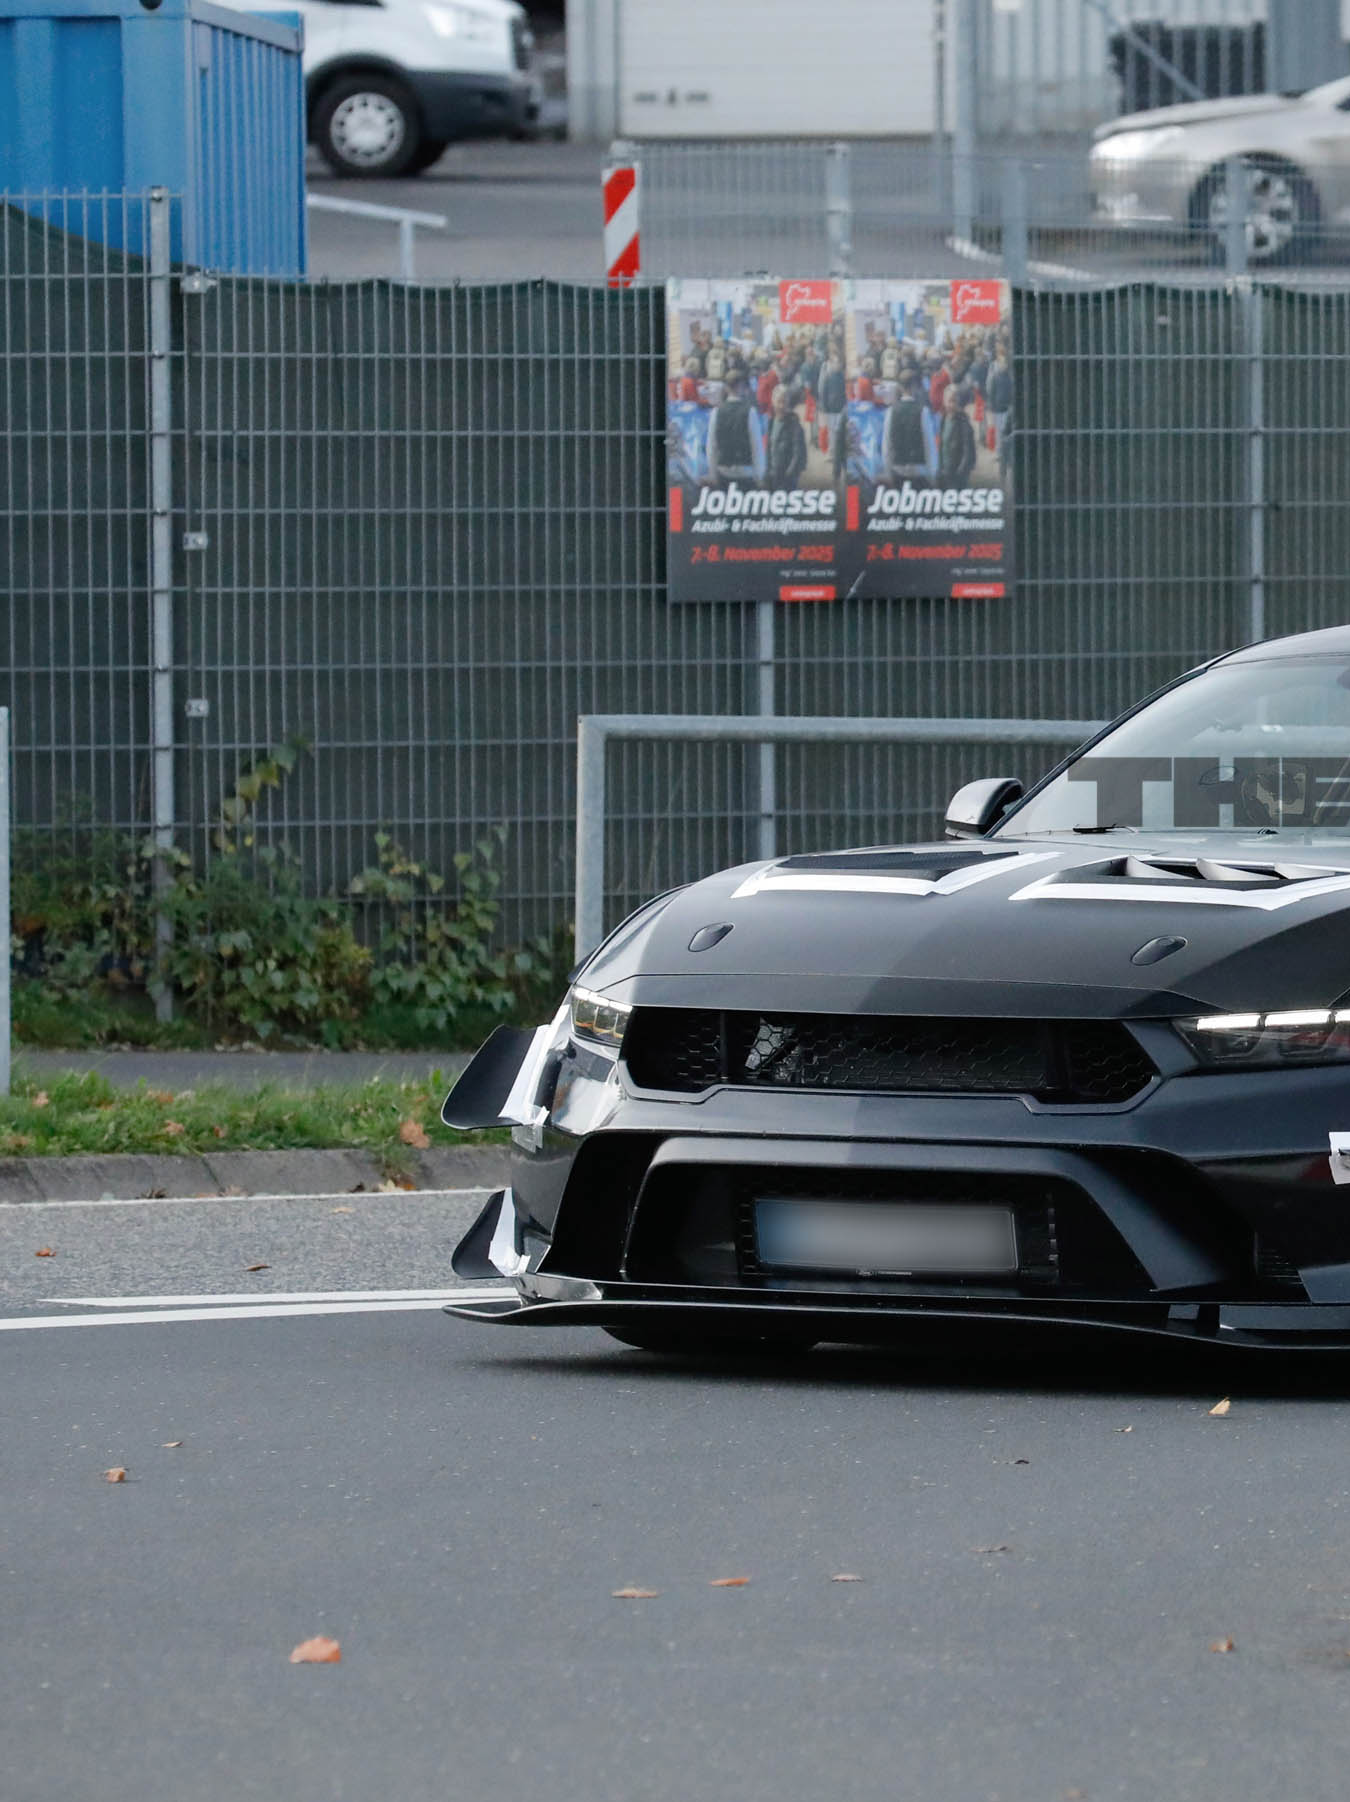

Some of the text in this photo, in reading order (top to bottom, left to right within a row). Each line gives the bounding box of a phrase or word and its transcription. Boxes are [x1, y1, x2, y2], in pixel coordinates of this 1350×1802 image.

[691, 482, 837, 516] Jobmesse
[867, 480, 1004, 514] Jobmesse
[691, 518, 729, 533] Azubi-
[742, 517, 837, 535] Fachkräftemesse
[723, 545, 796, 561] November
